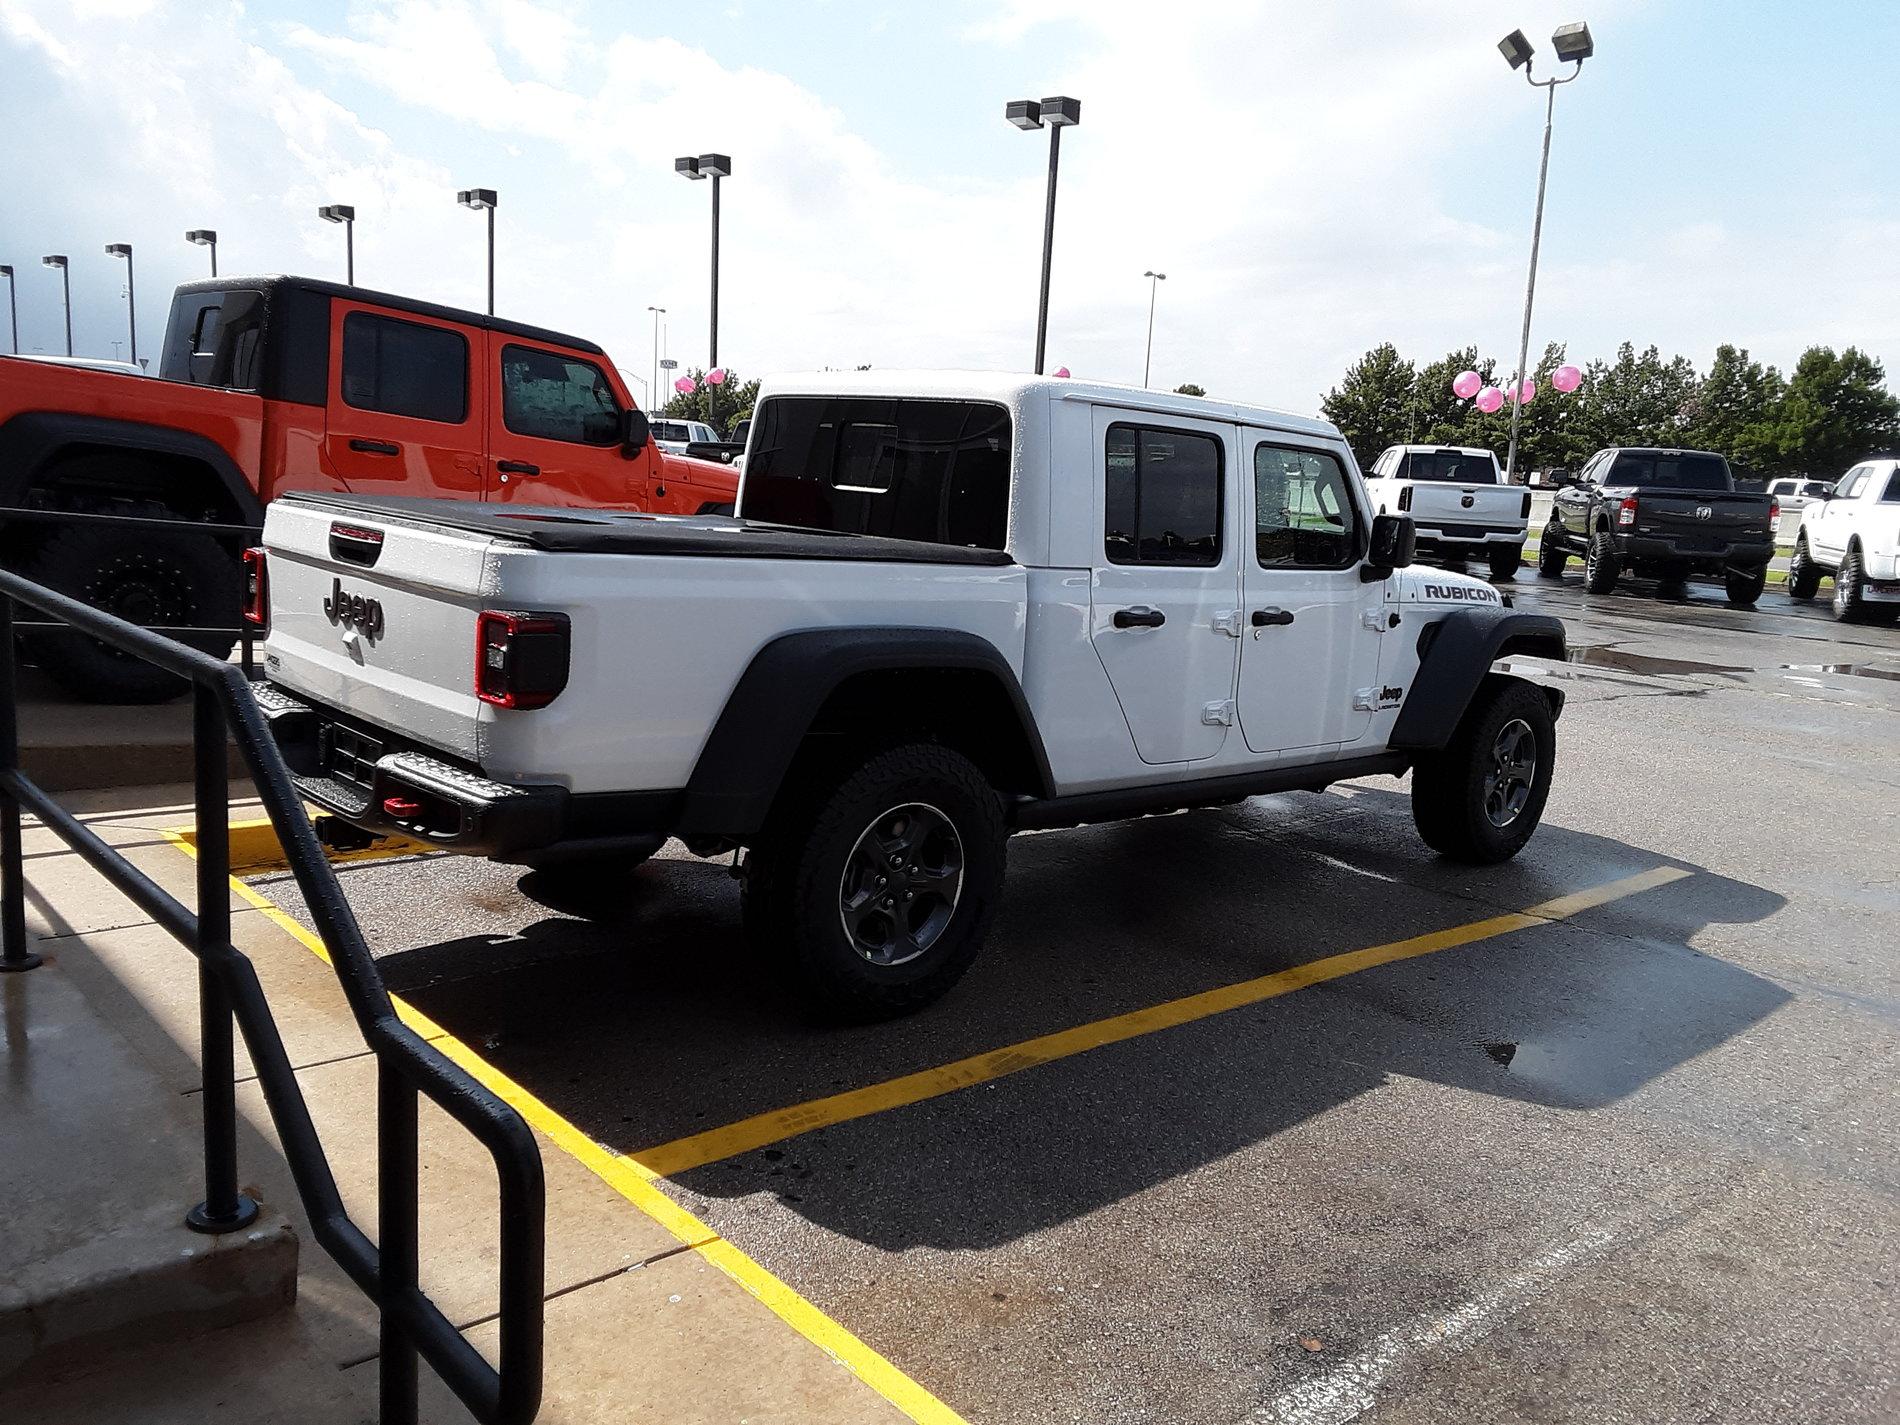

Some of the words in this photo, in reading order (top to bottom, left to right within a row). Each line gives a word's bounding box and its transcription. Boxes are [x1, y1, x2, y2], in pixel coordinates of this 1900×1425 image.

[1424, 584, 1498, 603] RUBICON
[323, 577, 383, 642] Jeep
[1379, 685, 1403, 702] Jeep
